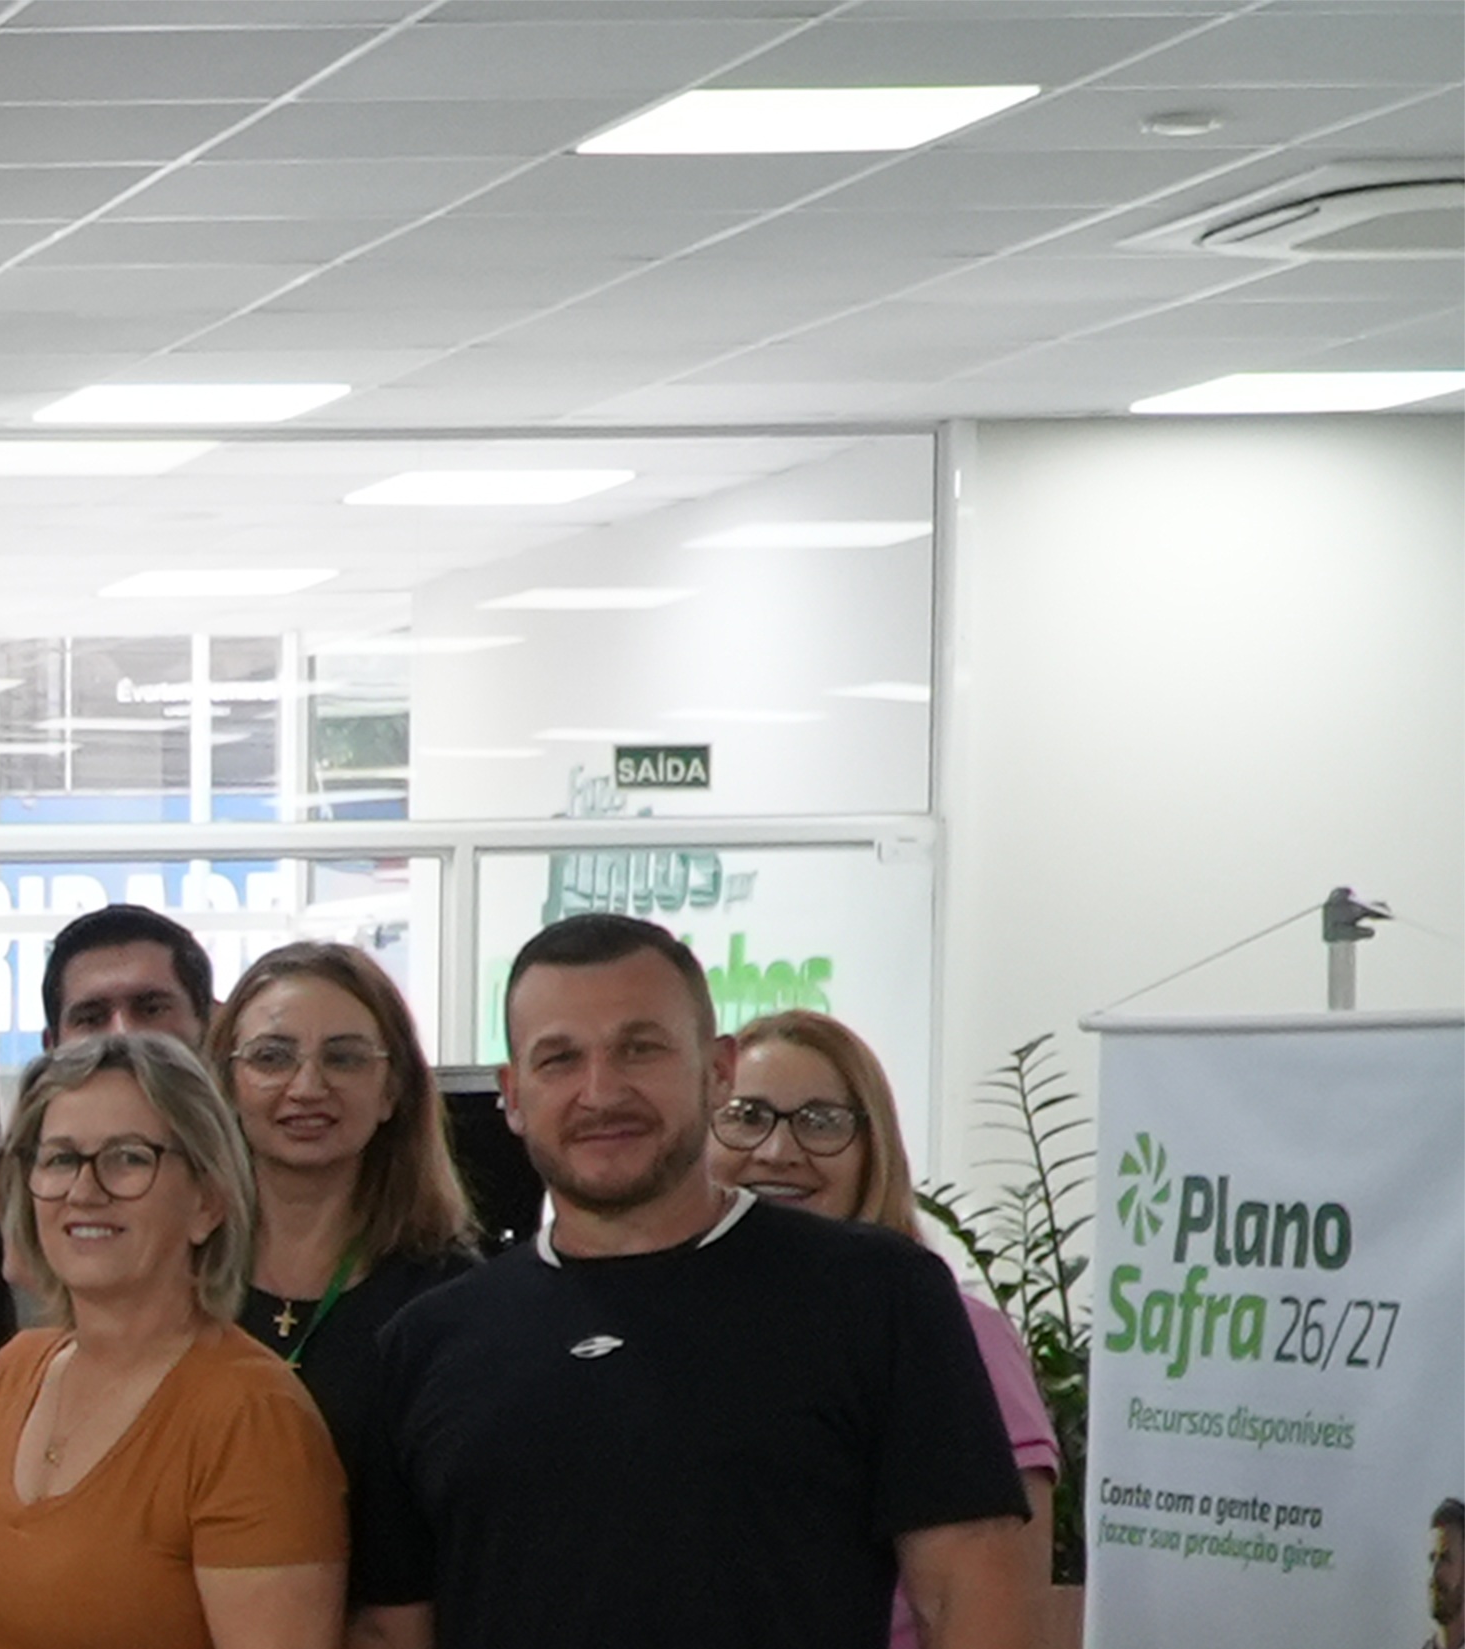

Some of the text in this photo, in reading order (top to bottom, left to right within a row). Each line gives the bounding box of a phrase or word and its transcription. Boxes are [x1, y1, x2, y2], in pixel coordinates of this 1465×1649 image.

[617, 752, 707, 784] SAÍDA
[1173, 1175, 1353, 1271] Plano
[1105, 1264, 1401, 1380] Safra 26/27
[1127, 1397, 1357, 1451] Recursos disponíveis
[1099, 1476, 1324, 1531] Conte com a gente para
[1096, 1514, 1145, 1547] fazer
[1148, 1524, 1181, 1551] sua
[1183, 1529, 1279, 1571] produção
